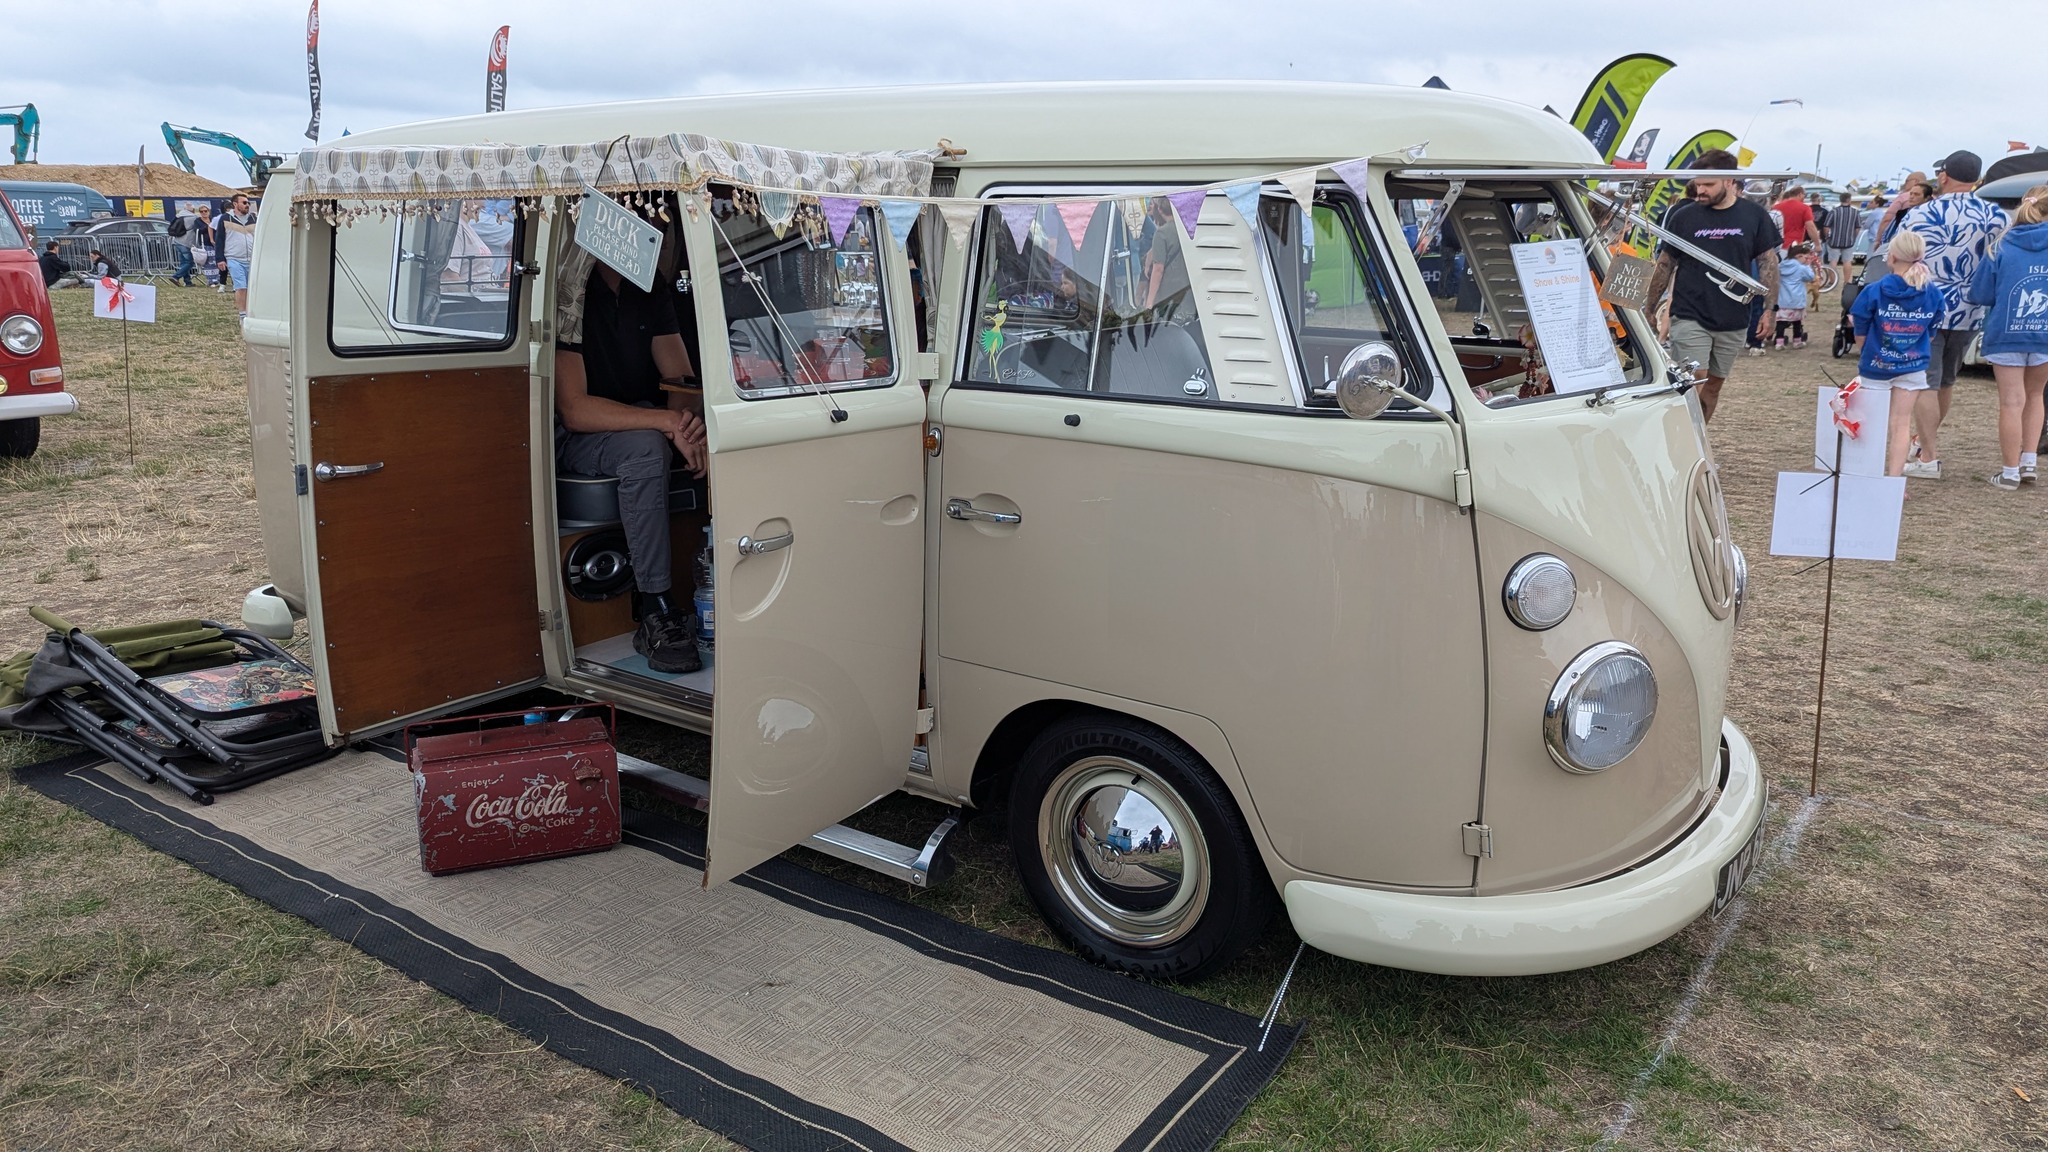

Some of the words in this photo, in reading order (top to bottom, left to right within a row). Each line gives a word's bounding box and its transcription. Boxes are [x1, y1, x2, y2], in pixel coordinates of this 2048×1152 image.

[595, 201, 641, 249] DUCK
[593, 223, 620, 248] PLEASE
[620, 241, 638, 259] MIND
[584, 229, 611, 257] YOUR
[613, 249, 641, 275] HEAD
[1621, 263, 1642, 278] NO
[1534, 276, 1553, 288] Show
[1554, 277, 1560, 285] &
[1560, 274, 1580, 285] Shine
[1614, 272, 1643, 289] RIFF
[1608, 283, 1641, 300] RAFF
[1878, 309, 1907, 318] WATER
[546, 817, 576, 828] Coke
